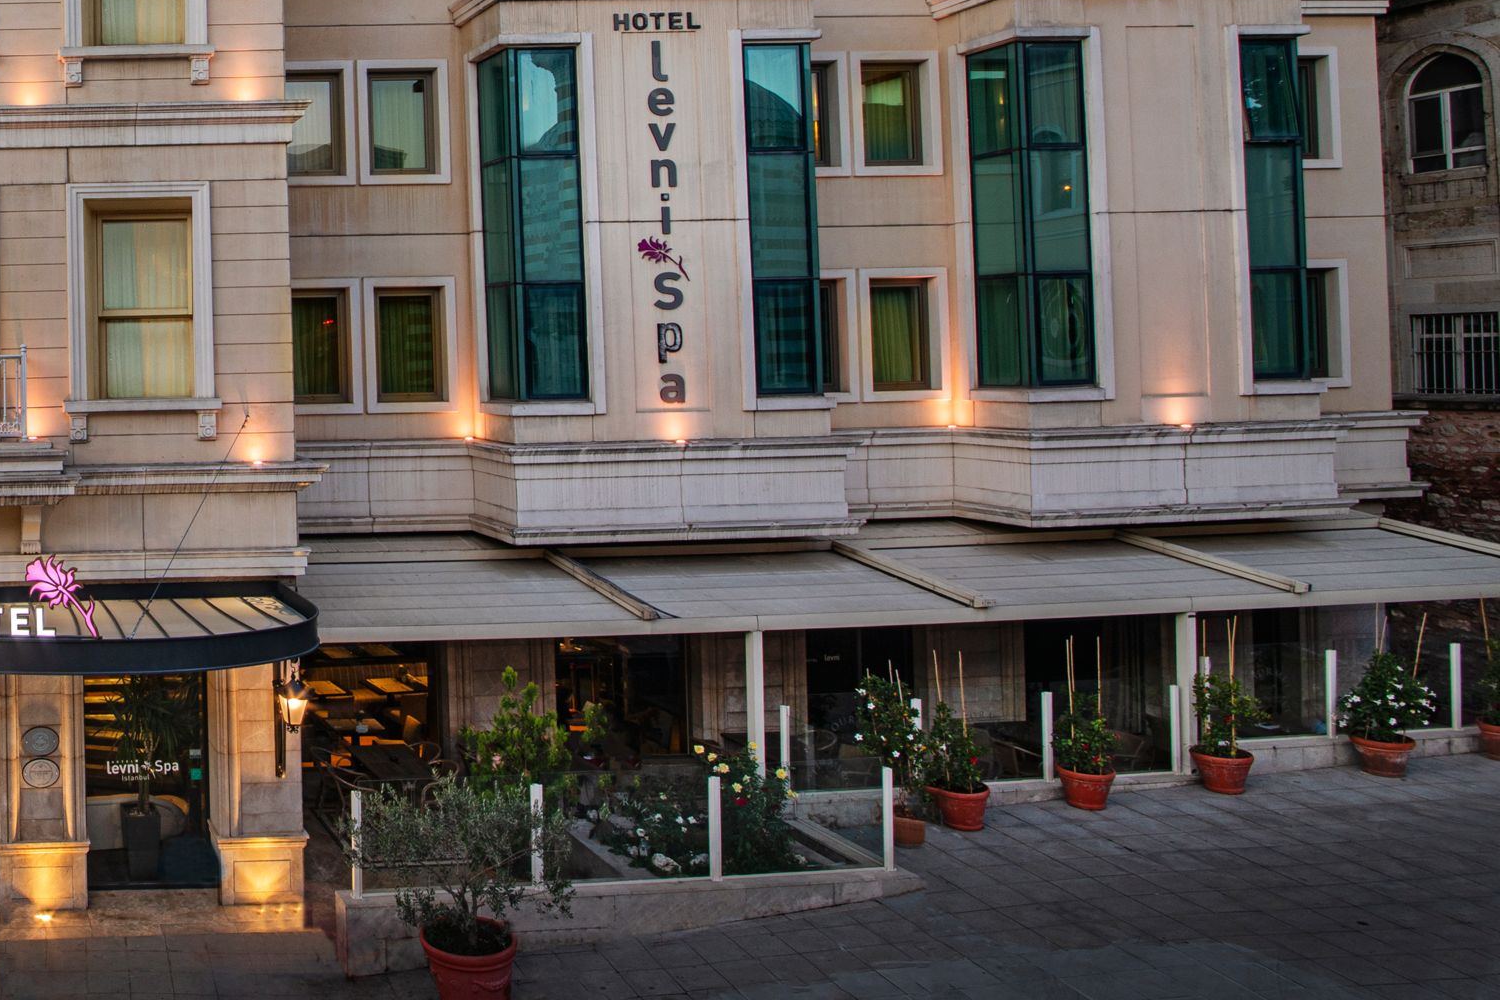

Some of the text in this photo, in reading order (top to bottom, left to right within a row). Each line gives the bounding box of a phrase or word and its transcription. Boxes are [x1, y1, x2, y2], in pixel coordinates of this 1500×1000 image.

[613, 12, 702, 31] HOTEL
[648, 40, 686, 404] levni Spa
[106, 760, 180, 774] levni Spa
